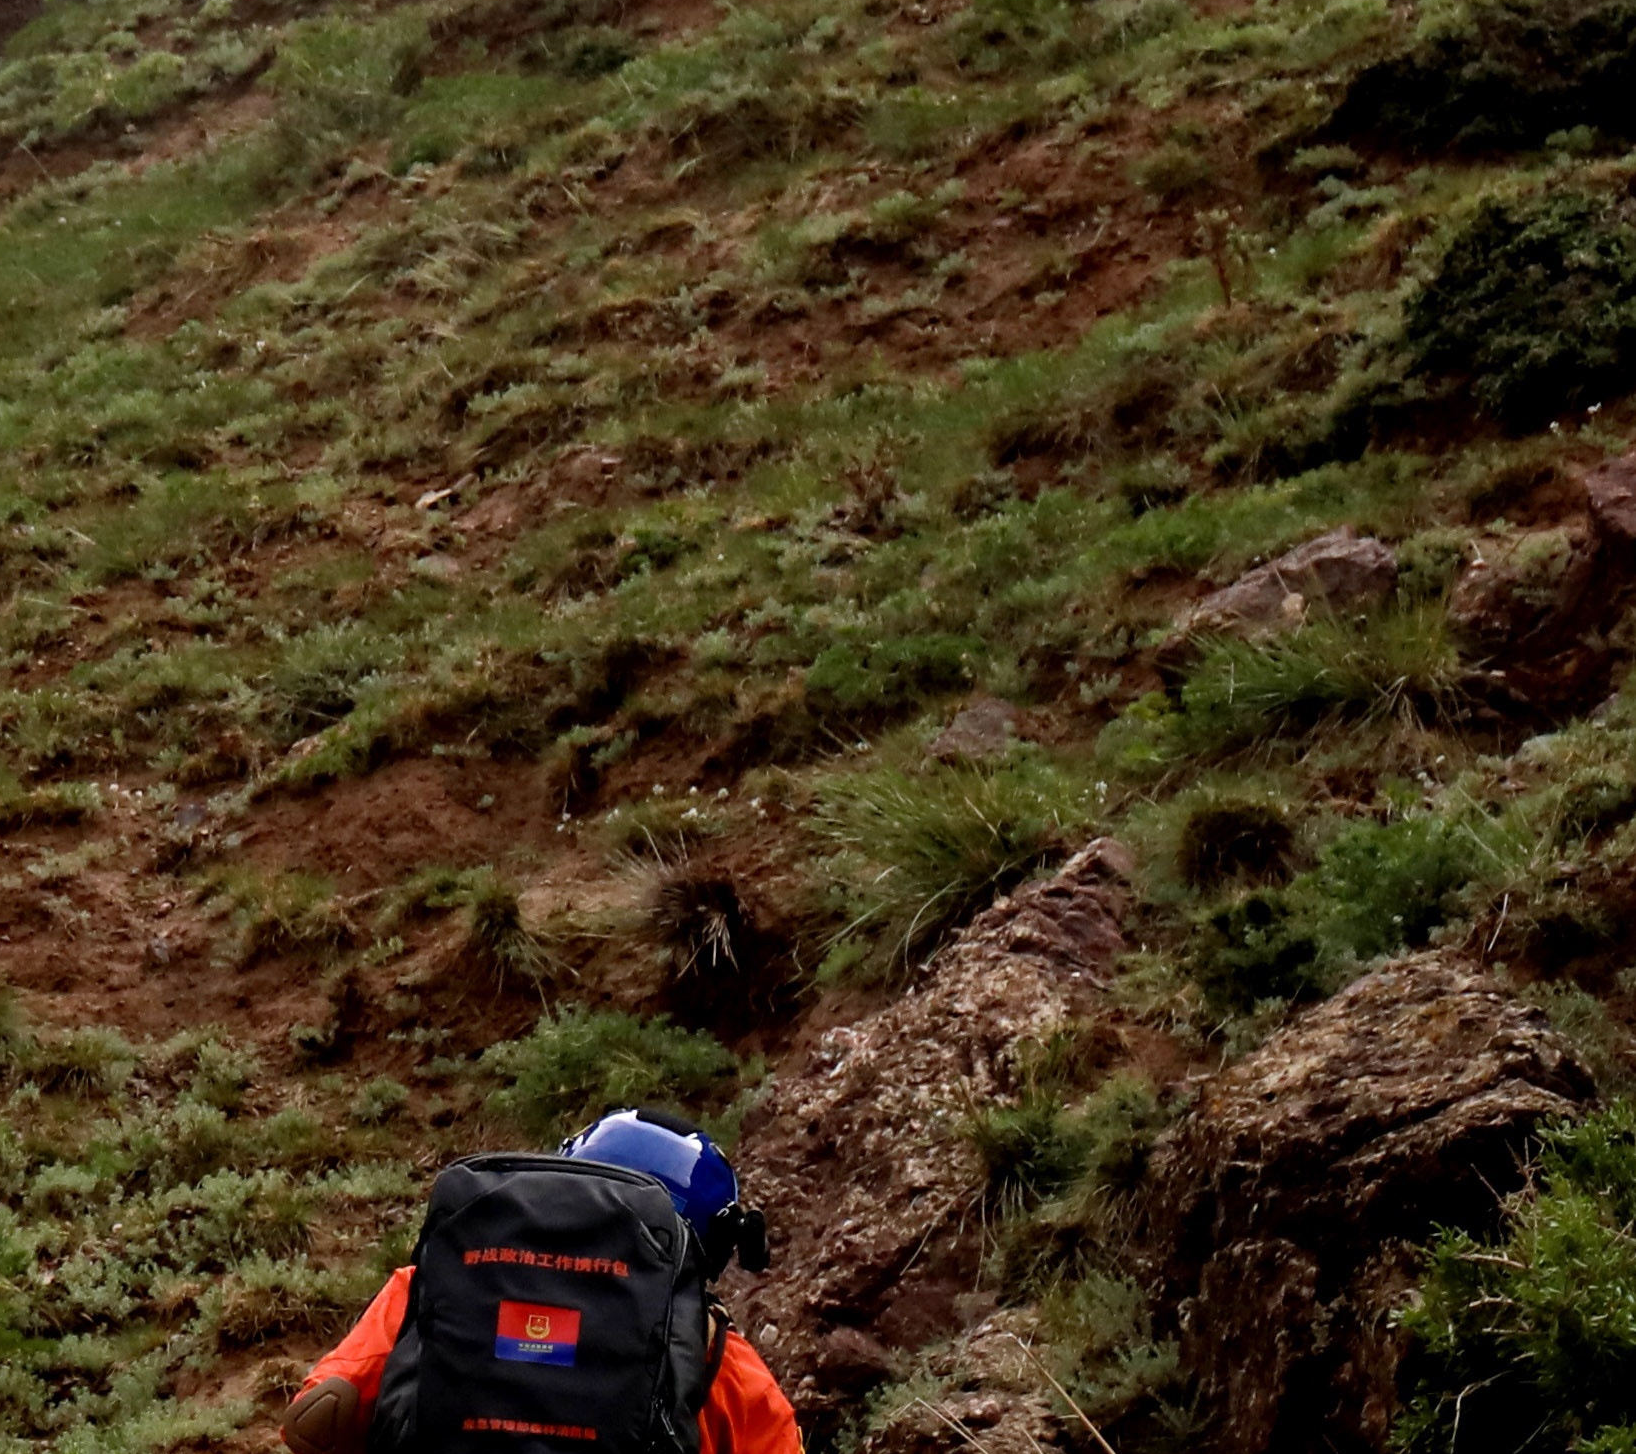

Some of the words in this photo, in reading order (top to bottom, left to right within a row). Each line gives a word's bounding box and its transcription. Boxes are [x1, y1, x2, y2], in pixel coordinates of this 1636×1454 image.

[463, 1248, 629, 1277] 野战政治工作携行包
